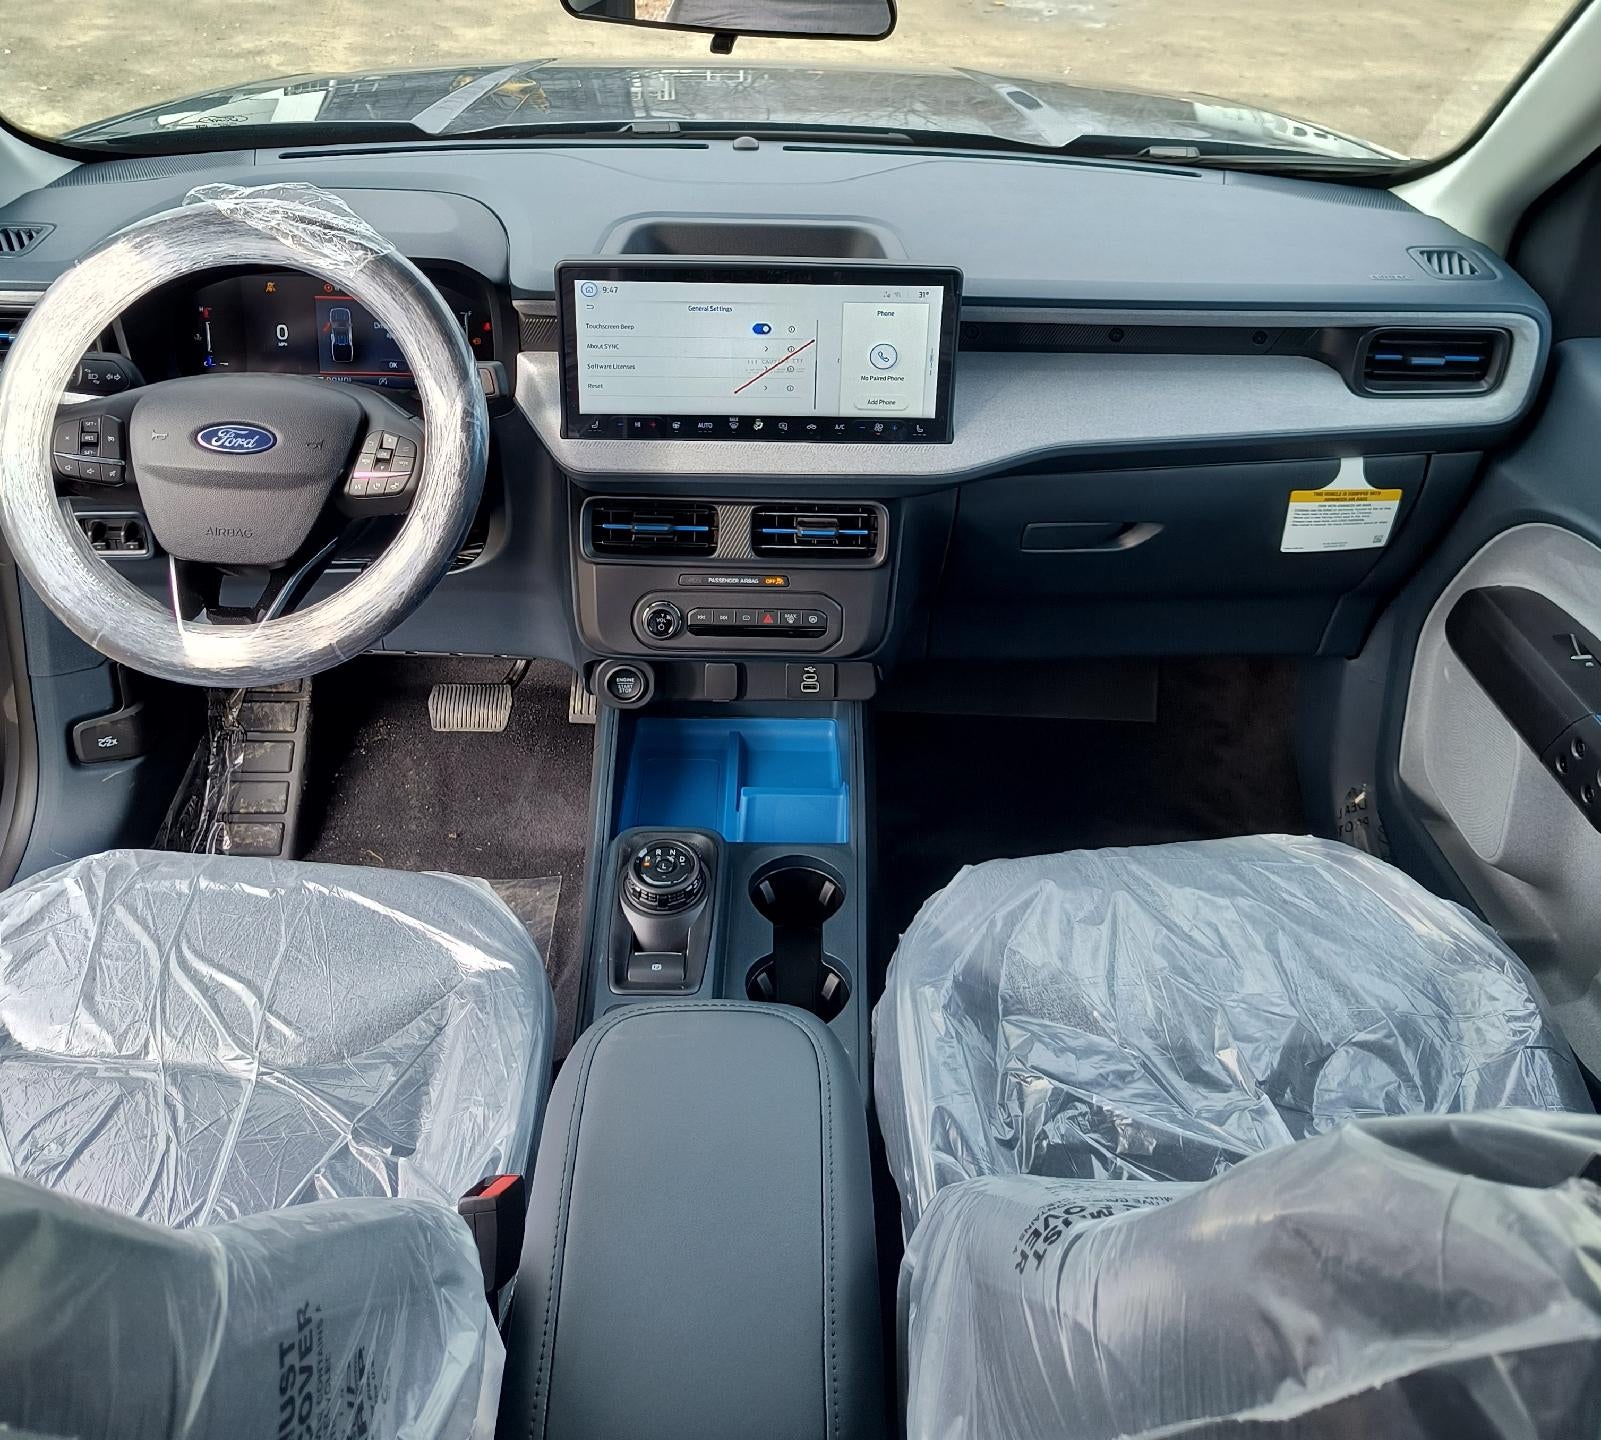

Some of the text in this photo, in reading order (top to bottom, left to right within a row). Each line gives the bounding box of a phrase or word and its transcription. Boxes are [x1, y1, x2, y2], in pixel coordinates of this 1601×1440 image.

[602, 286, 619, 294] 9:47
[709, 305, 733, 313] Settings
[276, 324, 289, 341] 0
[211, 428, 260, 448] Ford
[205, 526, 254, 538] AIRBAG
[679, 855, 686, 863] D
